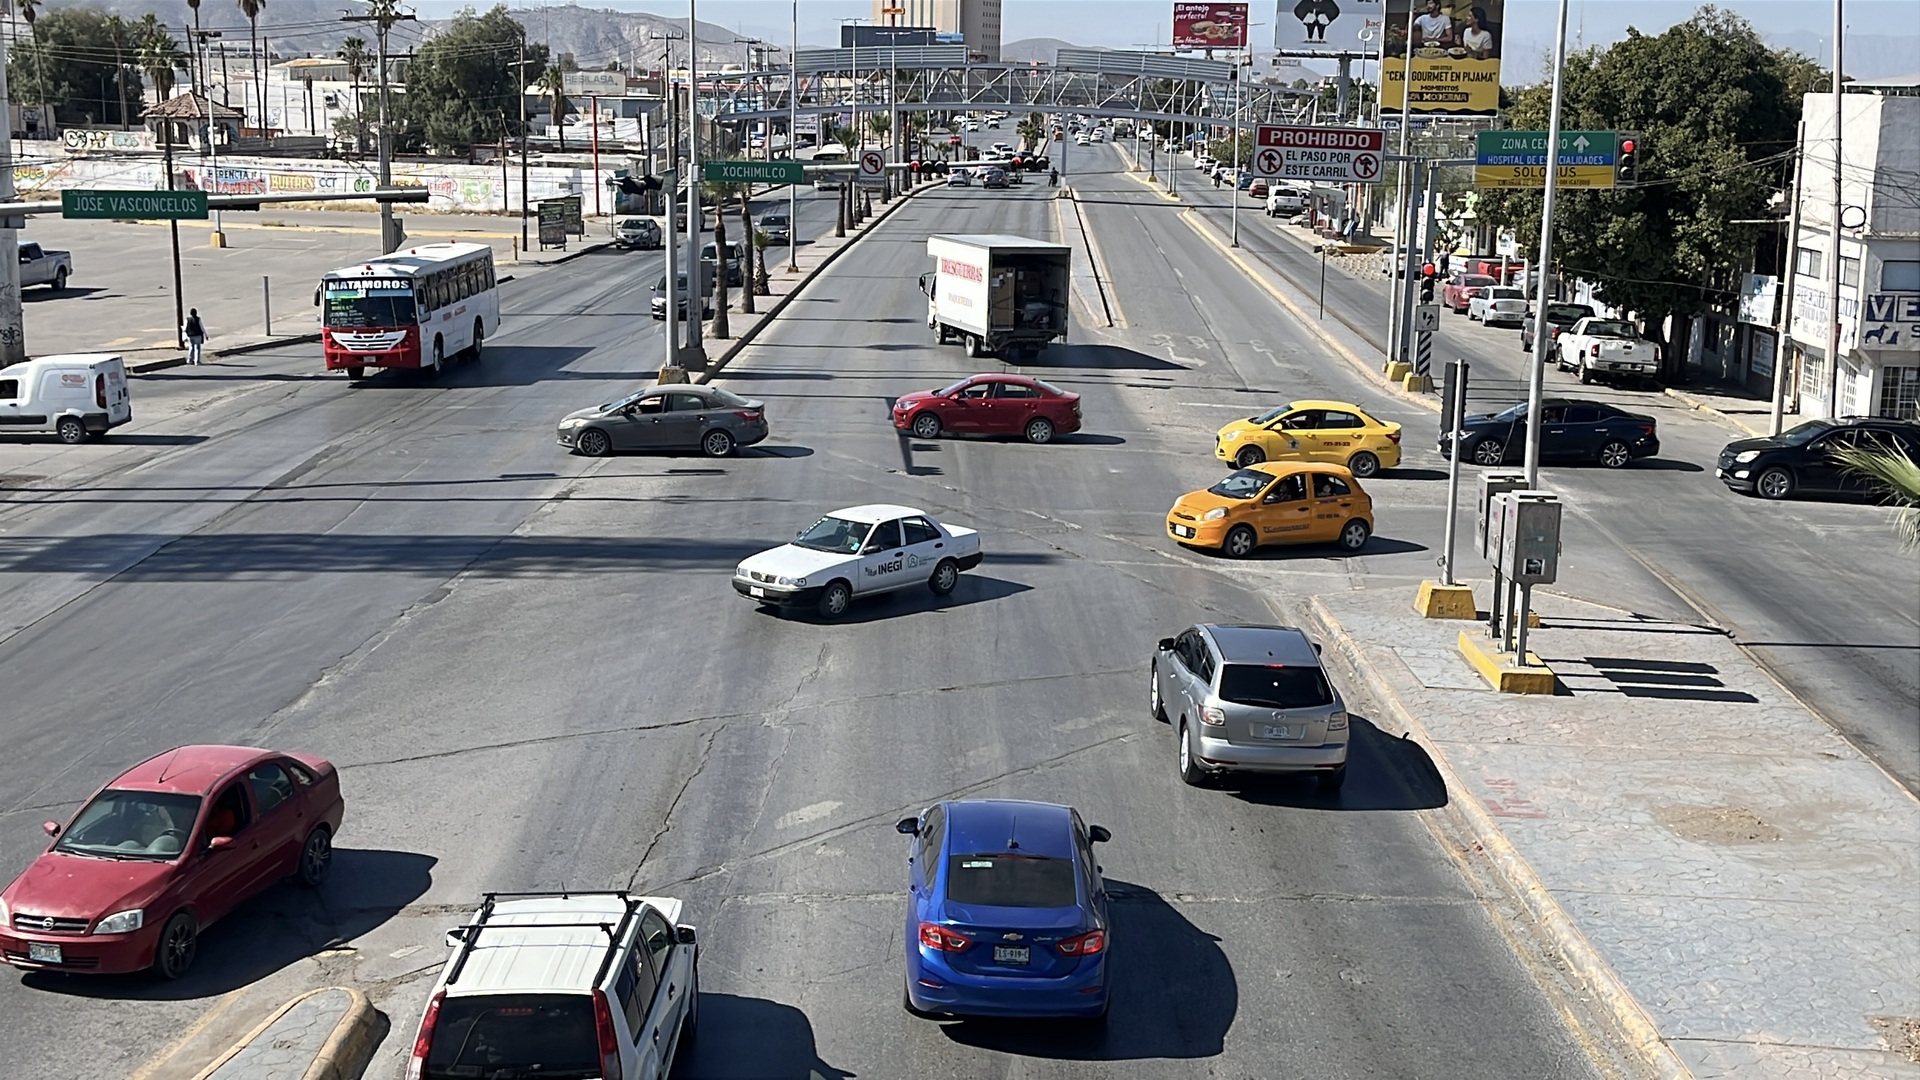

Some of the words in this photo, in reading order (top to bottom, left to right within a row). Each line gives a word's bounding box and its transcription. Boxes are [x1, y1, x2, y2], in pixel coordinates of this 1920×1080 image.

[1185, 5, 1209, 13] antojo
[1175, 11, 1208, 22] perfecto!
[1386, 71, 1406, 81] "CEN
[1411, 71, 1449, 82] GOURMET
[1451, 71, 1461, 82] EN
[1462, 72, 1496, 83] PIJAMA"
[1270, 130, 1370, 148] PROHIBIDO
[1502, 138, 1528, 150] ZONA
[1286, 150, 1298, 161] EL
[1300, 151, 1327, 162] PASO
[1329, 152, 1351, 163] POR
[1487, 155, 1523, 164] HOSPITAL
[1526, 155, 1537, 164] DE
[1539, 155, 1603, 165] ESCIALIDADES
[722, 167, 786, 179] XOCHIMILCO
[1285, 164, 1310, 176] ESTE
[1312, 165, 1349, 177] CARRIL
[270, 174, 315, 192] BUITRES
[319, 177, 337, 188] CCT
[74, 196, 104, 212] JOSE
[109, 197, 198, 213] VASCONCELOS
[328, 279, 410, 291] MATAMOROS
[878, 560, 903, 575] INEGI
